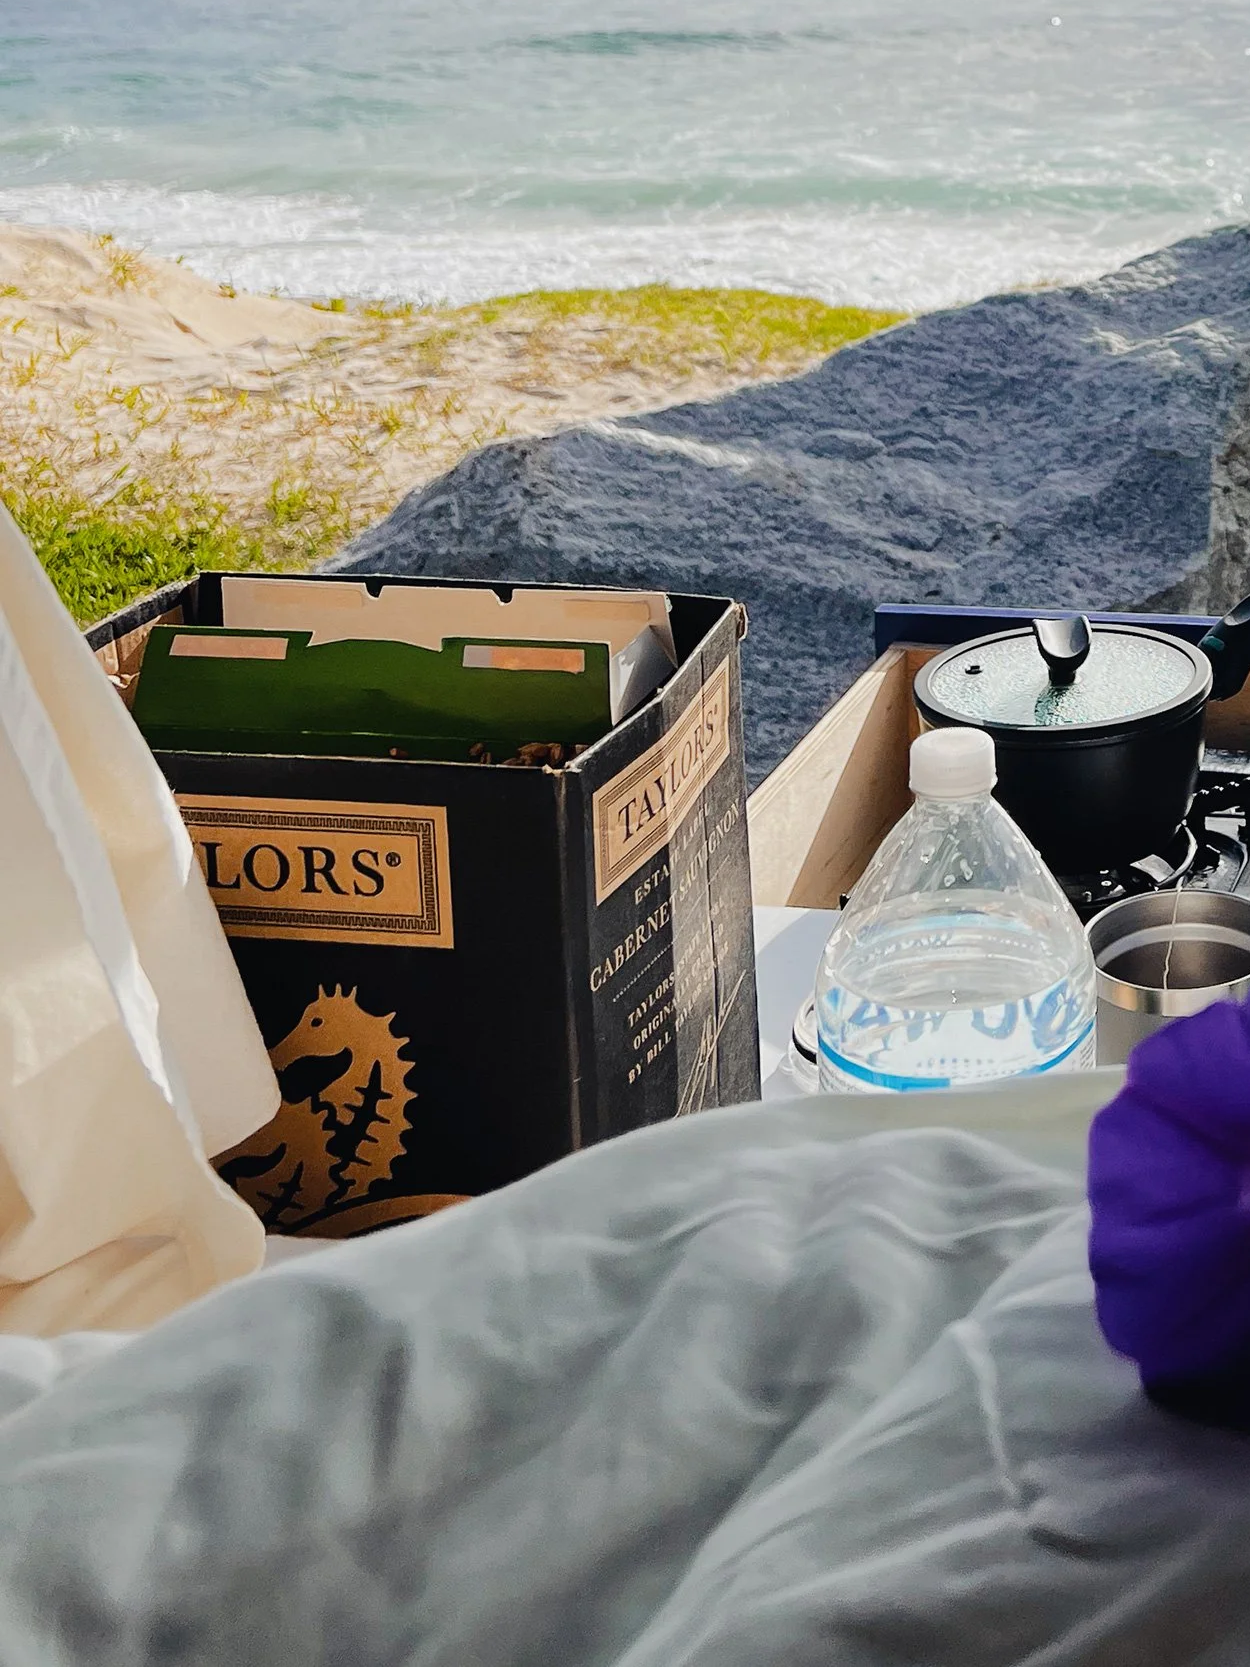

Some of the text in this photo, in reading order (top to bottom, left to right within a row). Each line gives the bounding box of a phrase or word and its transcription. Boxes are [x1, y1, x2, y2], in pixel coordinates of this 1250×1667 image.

[200, 842, 402, 897] LORS®
[589, 890, 677, 992] CABERNET
[679, 798, 740, 901] SAUVIGNON
[628, 971, 675, 1029] TAYLORS
[628, 1058, 643, 1084] BY
[646, 1031, 672, 1064] BILL
